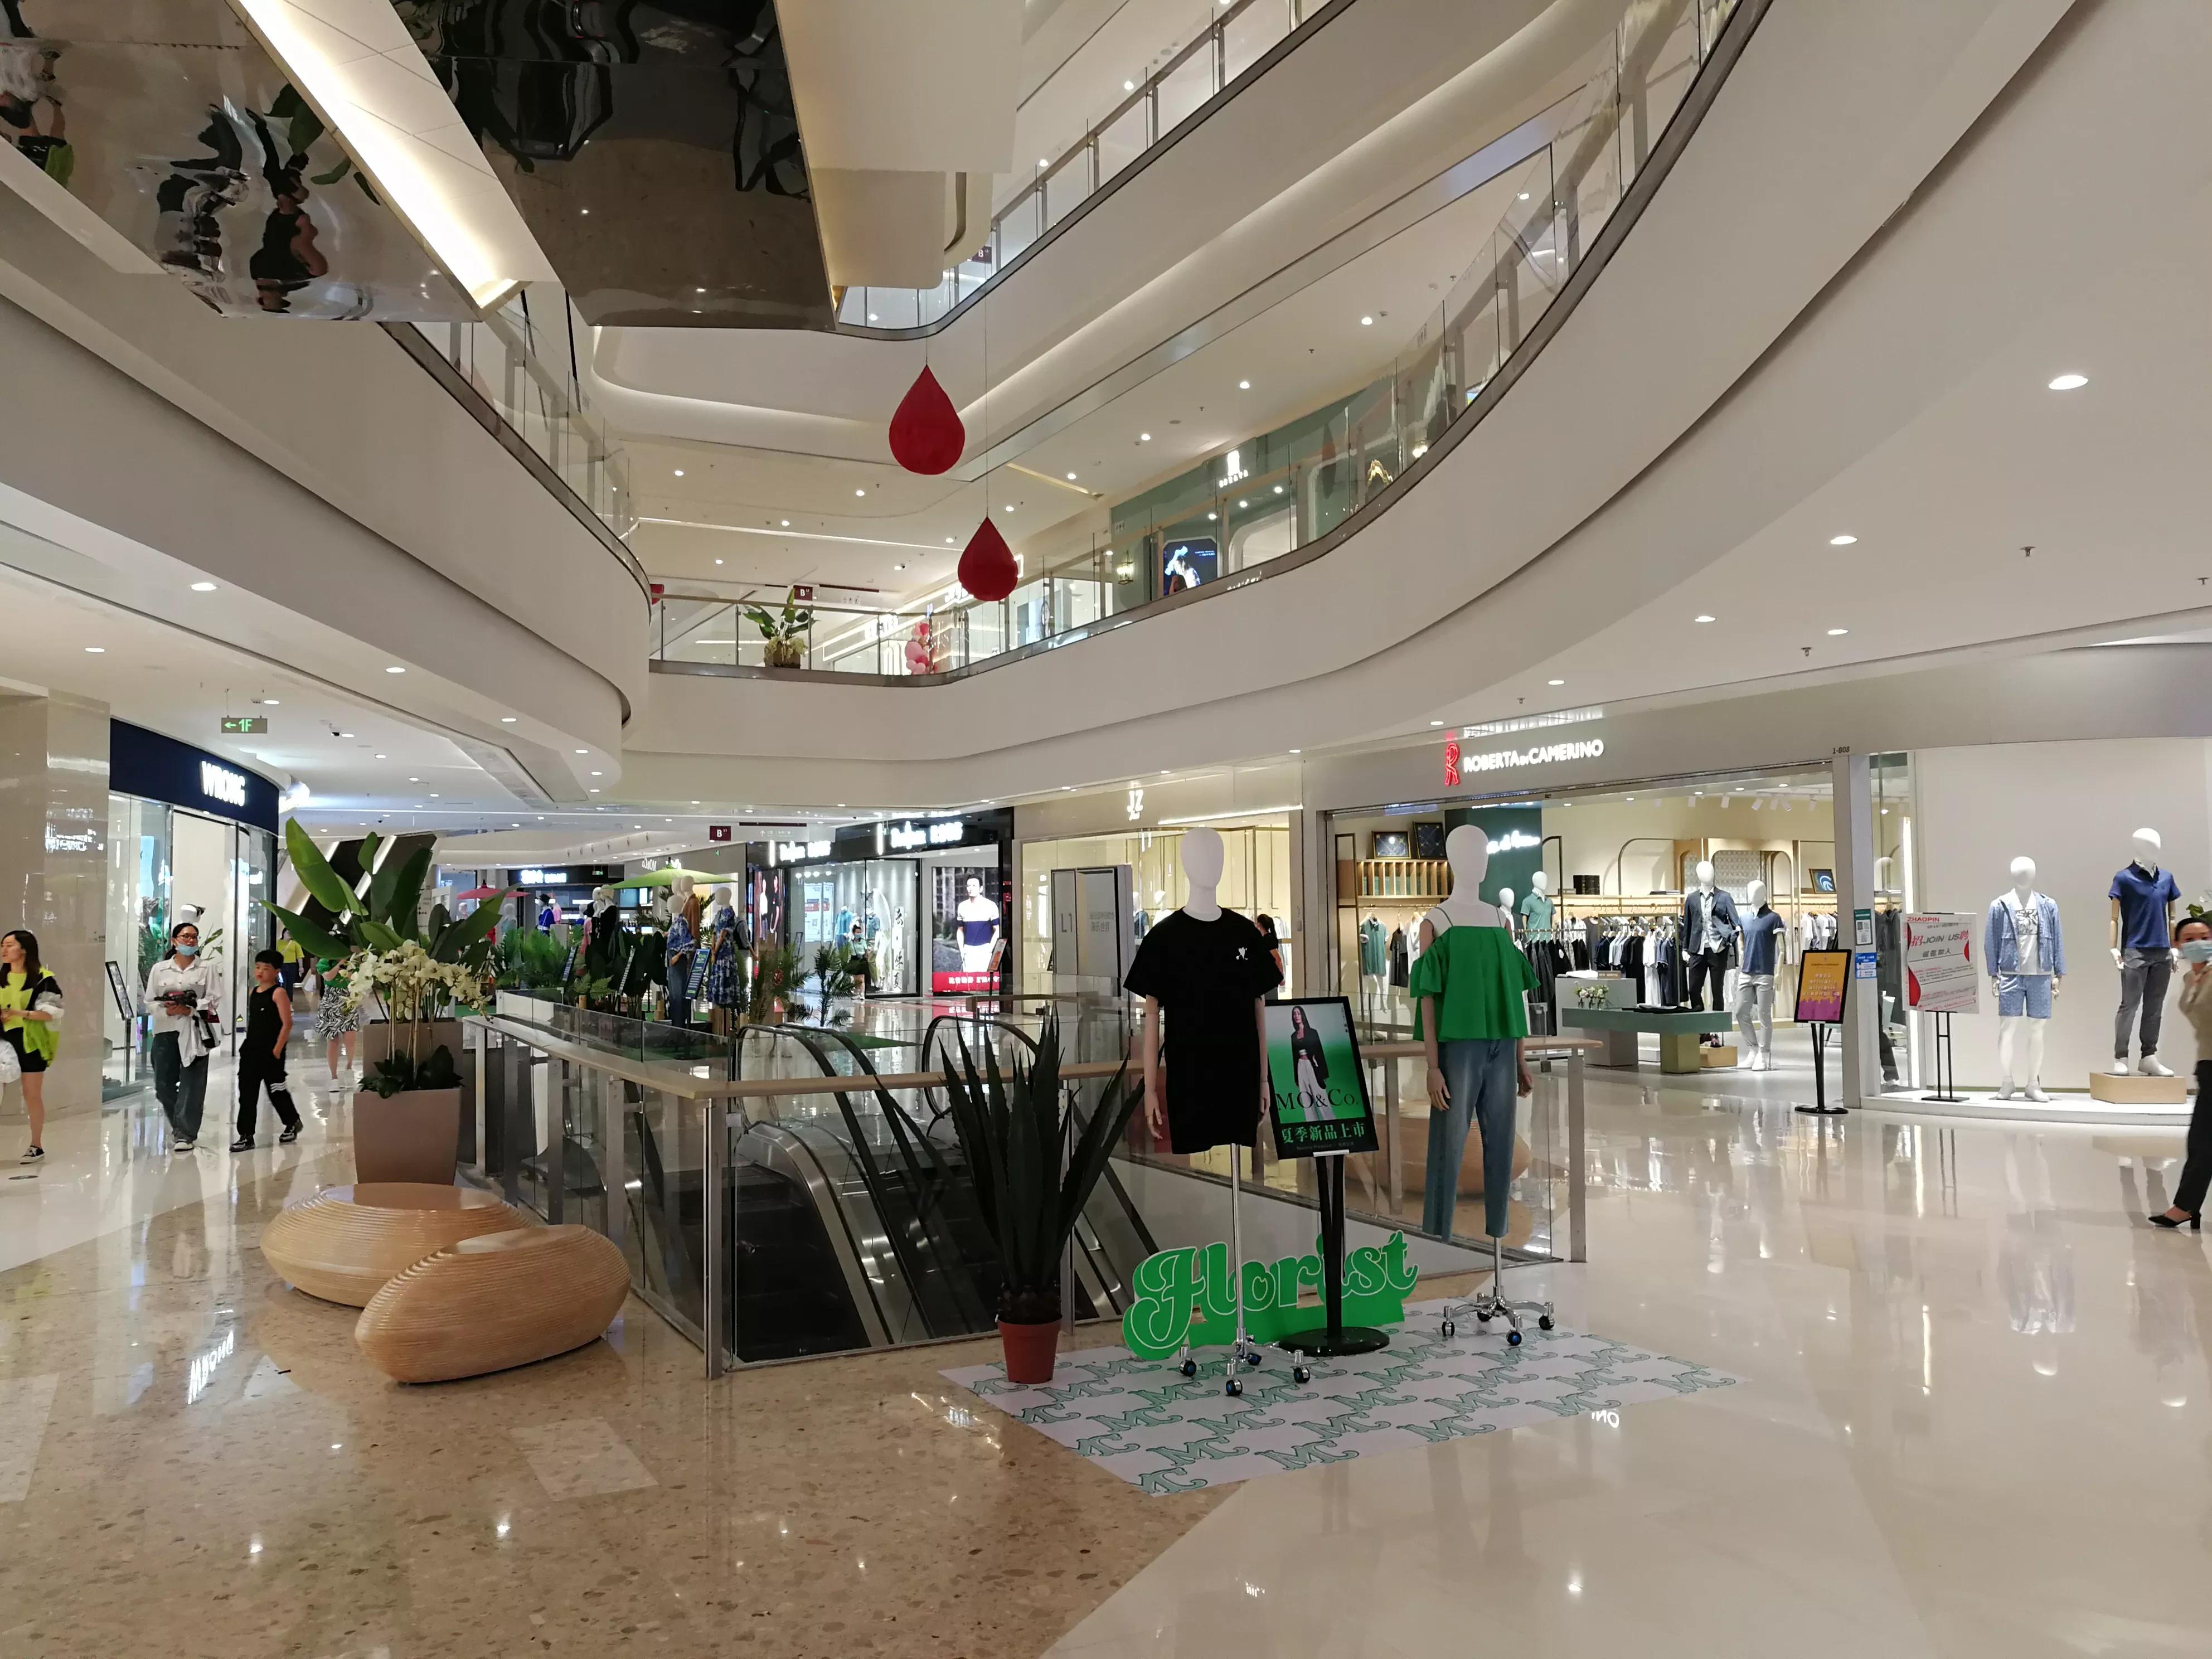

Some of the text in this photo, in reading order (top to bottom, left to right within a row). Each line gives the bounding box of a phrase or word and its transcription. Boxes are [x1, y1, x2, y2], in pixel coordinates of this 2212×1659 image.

[239, 719, 252, 732] 1F
[1923, 935, 1944, 944] JOIN
[1275, 1088, 1359, 1111] MO&Co.
[1282, 1122, 1365, 1144] 夏季新品上市
